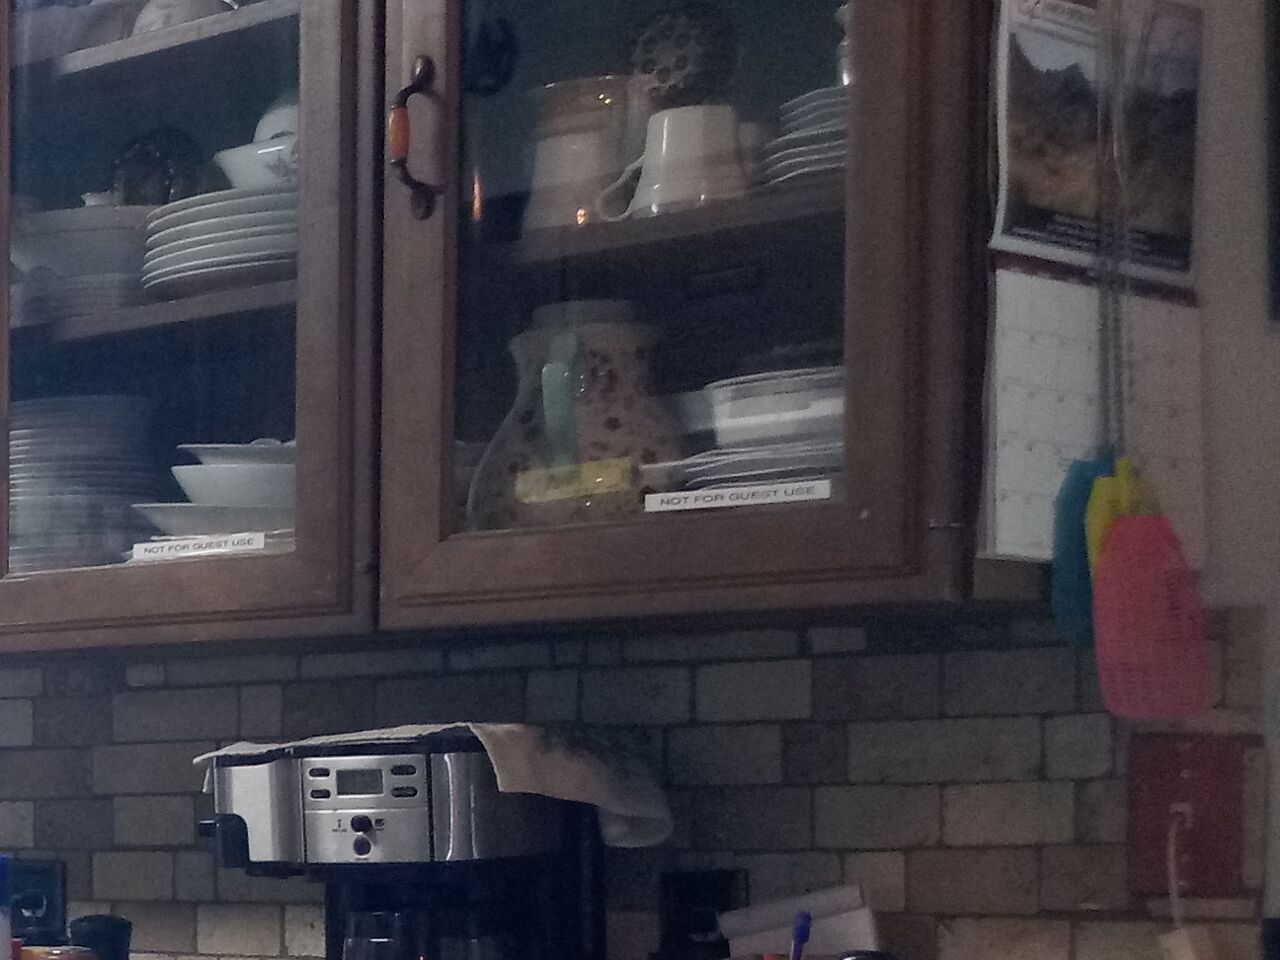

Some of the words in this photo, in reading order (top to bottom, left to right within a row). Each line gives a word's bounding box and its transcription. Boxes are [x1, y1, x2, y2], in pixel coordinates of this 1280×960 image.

[659, 496, 689, 506] NOT
[693, 494, 725, 504] FOR
[728, 489, 779, 501] GUEST
[783, 485, 816, 497] USE
[144, 545, 165, 555] NOT
[167, 543, 190, 552] FOR
[192, 540, 228, 550] GUEST
[231, 537, 255, 547] USE
